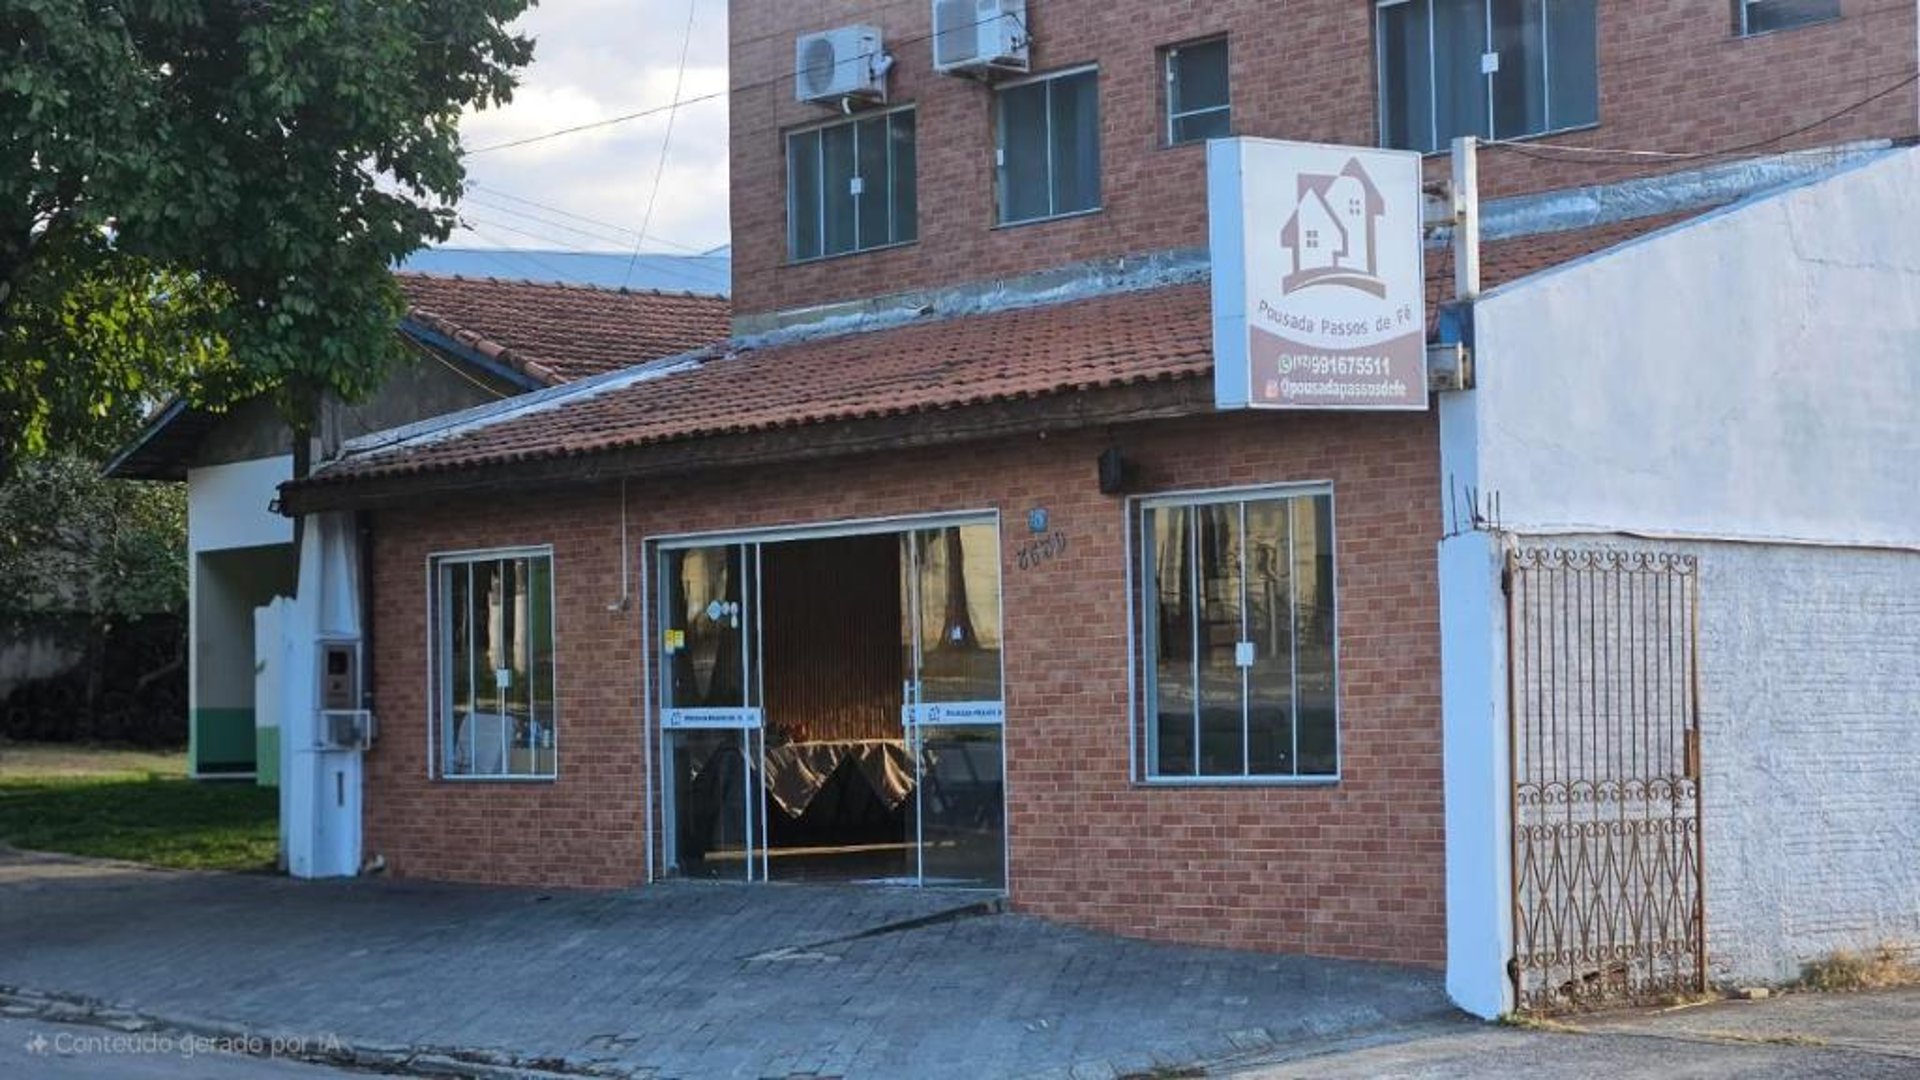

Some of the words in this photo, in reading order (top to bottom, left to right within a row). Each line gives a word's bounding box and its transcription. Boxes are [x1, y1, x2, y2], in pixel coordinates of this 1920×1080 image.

[1258, 299, 1313, 333] Pousada
[1321, 318, 1368, 336] Passos
[1375, 315, 1392, 333] de
